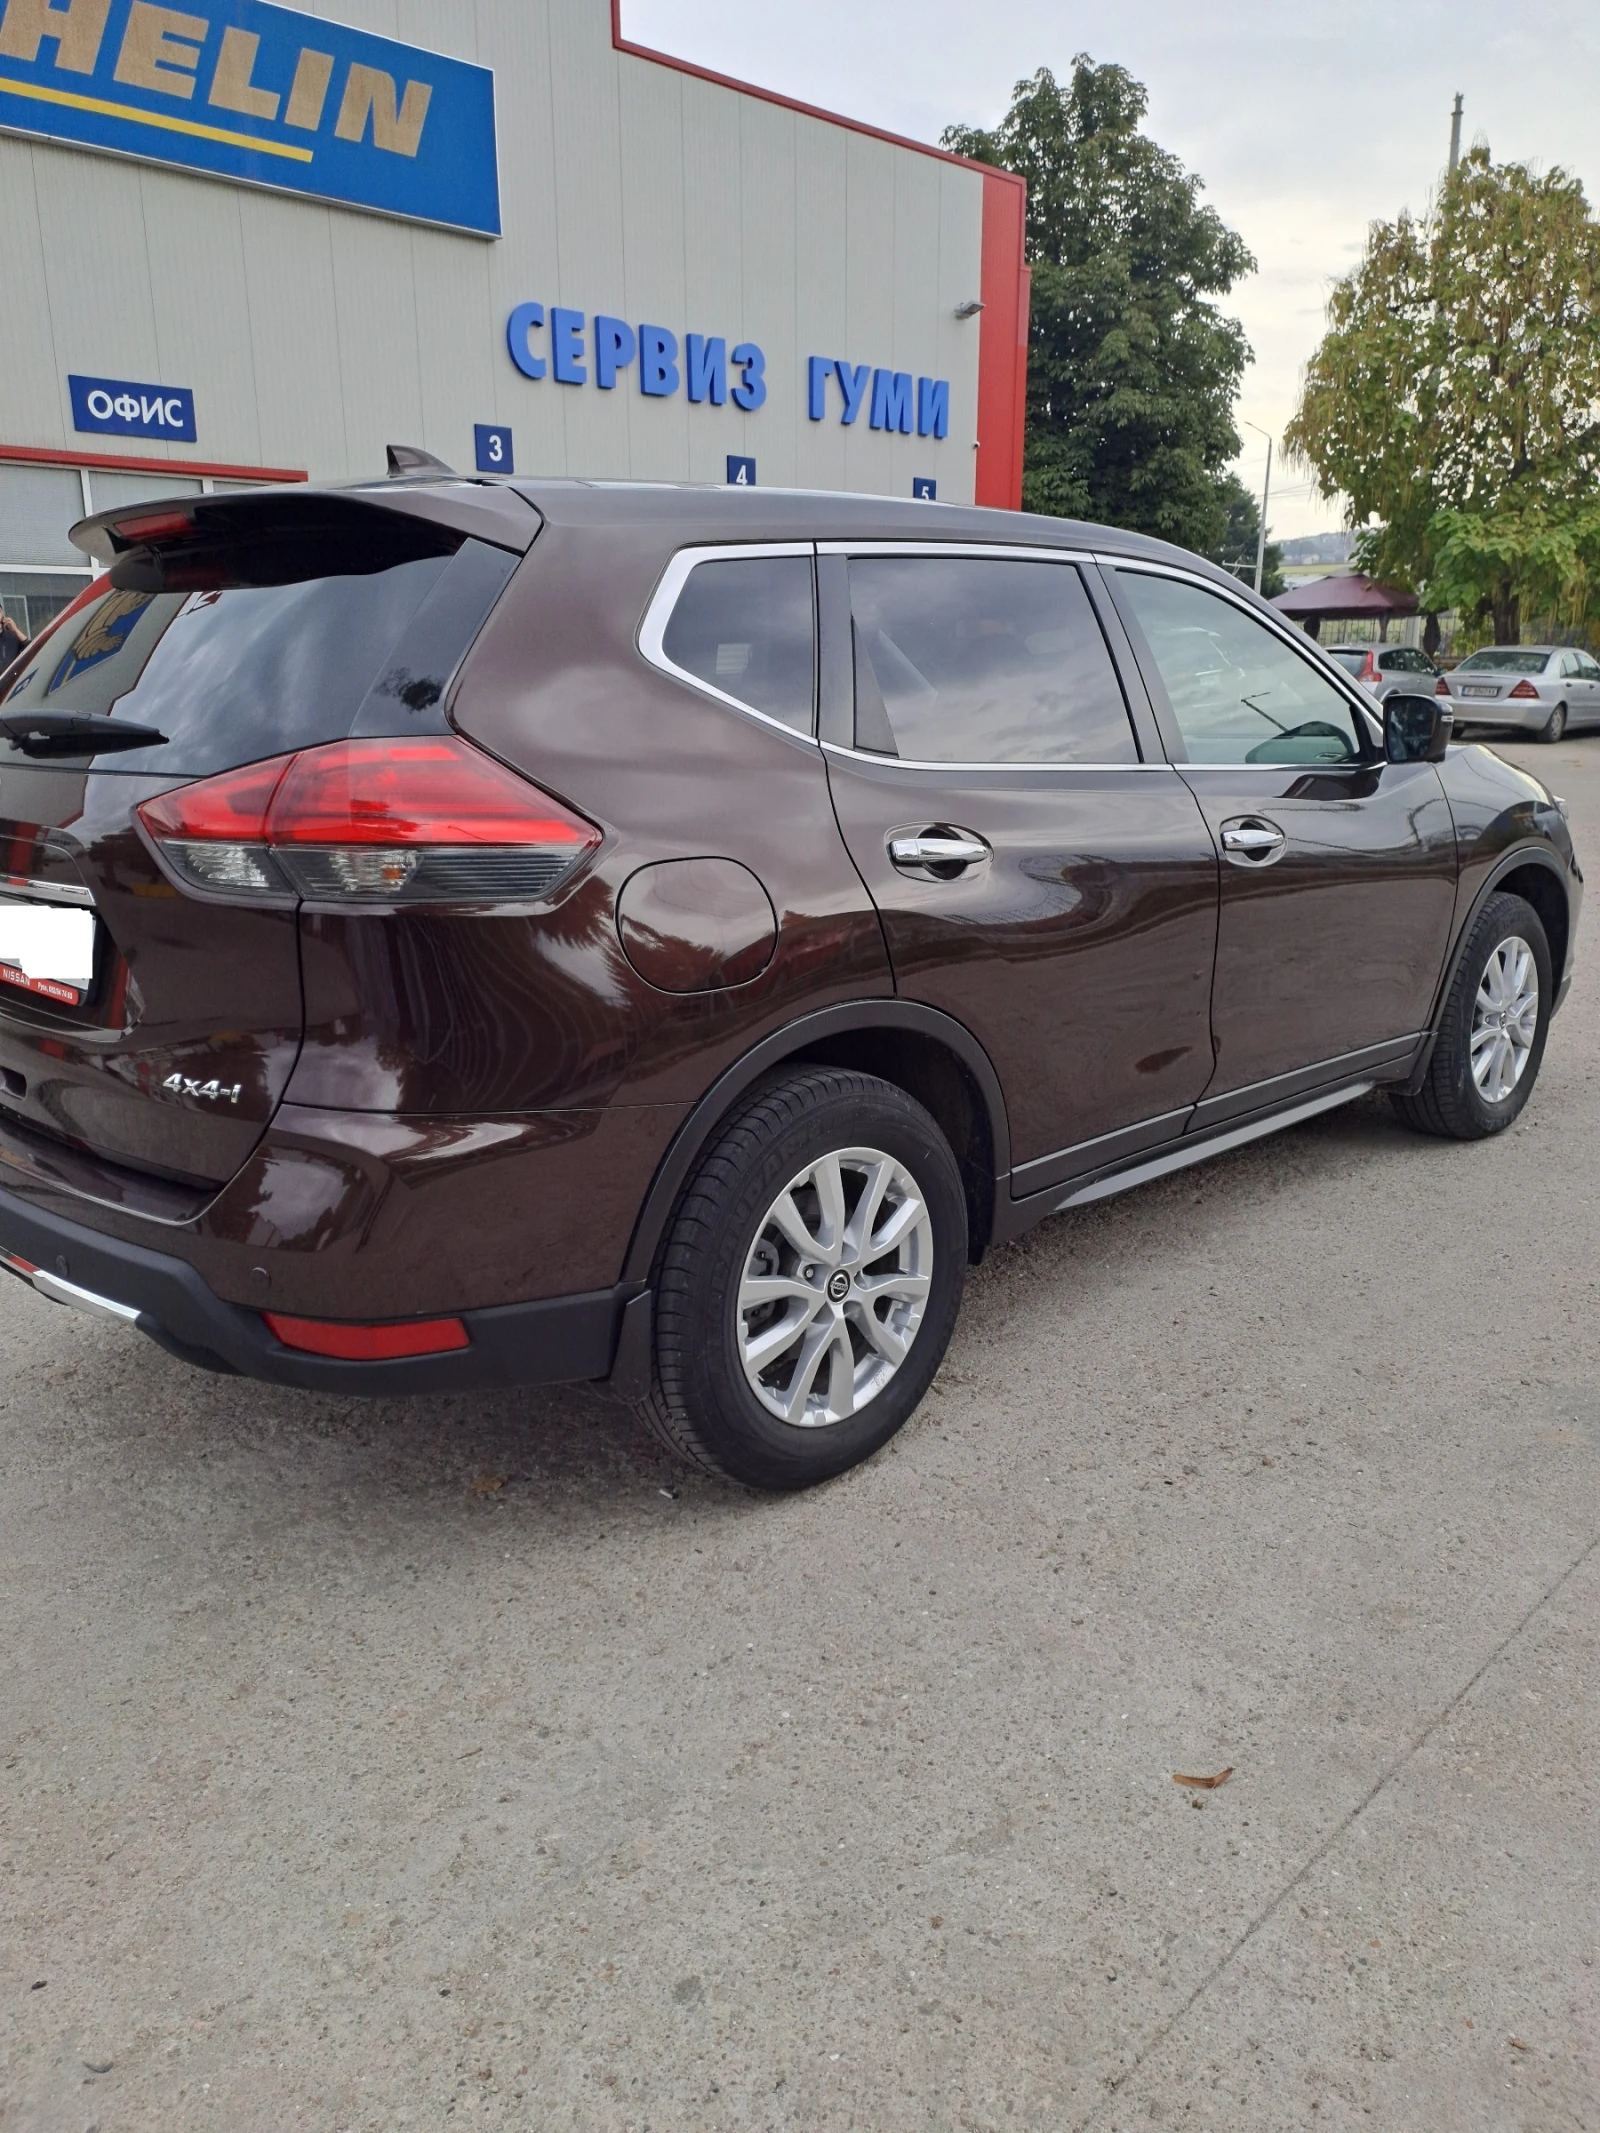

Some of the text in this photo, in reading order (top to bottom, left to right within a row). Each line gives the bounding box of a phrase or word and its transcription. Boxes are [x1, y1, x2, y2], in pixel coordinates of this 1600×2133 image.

[507, 301, 950, 439] СЕРВИЗ ГУМИ
[87, 390, 183, 428] ОФИС
[489, 434, 502, 461] 3
[736, 464, 748, 486] 4
[921, 486, 930, 500] 5
[2, 968, 30, 987] NISSAN
